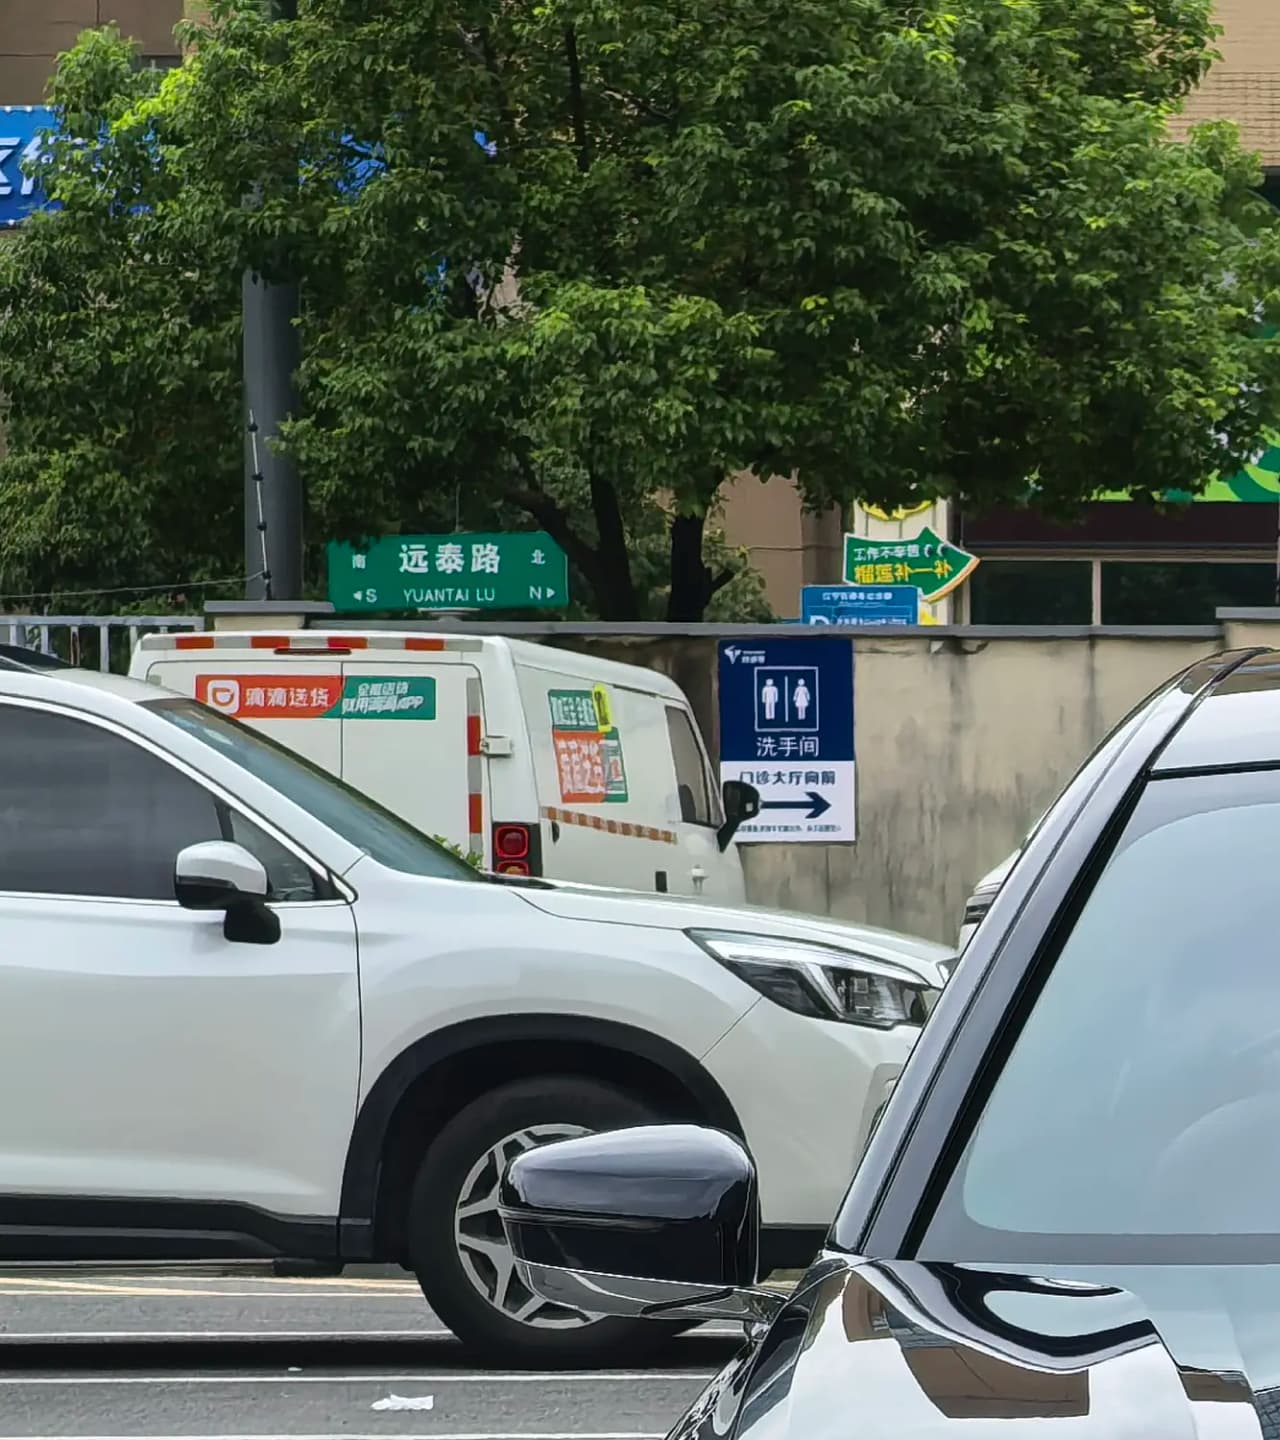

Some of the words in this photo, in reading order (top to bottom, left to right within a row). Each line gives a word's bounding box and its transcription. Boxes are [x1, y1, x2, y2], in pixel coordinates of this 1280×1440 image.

[399, 542, 501, 574] 远泰路
[530, 549, 546, 565] 北
[365, 588, 378, 604] S
[403, 588, 470, 603] YUANTAI
[475, 587, 496, 602] LU
[529, 585, 543, 600] N
[244, 687, 330, 709] 滴滴送货
[756, 735, 820, 757] 洗手间
